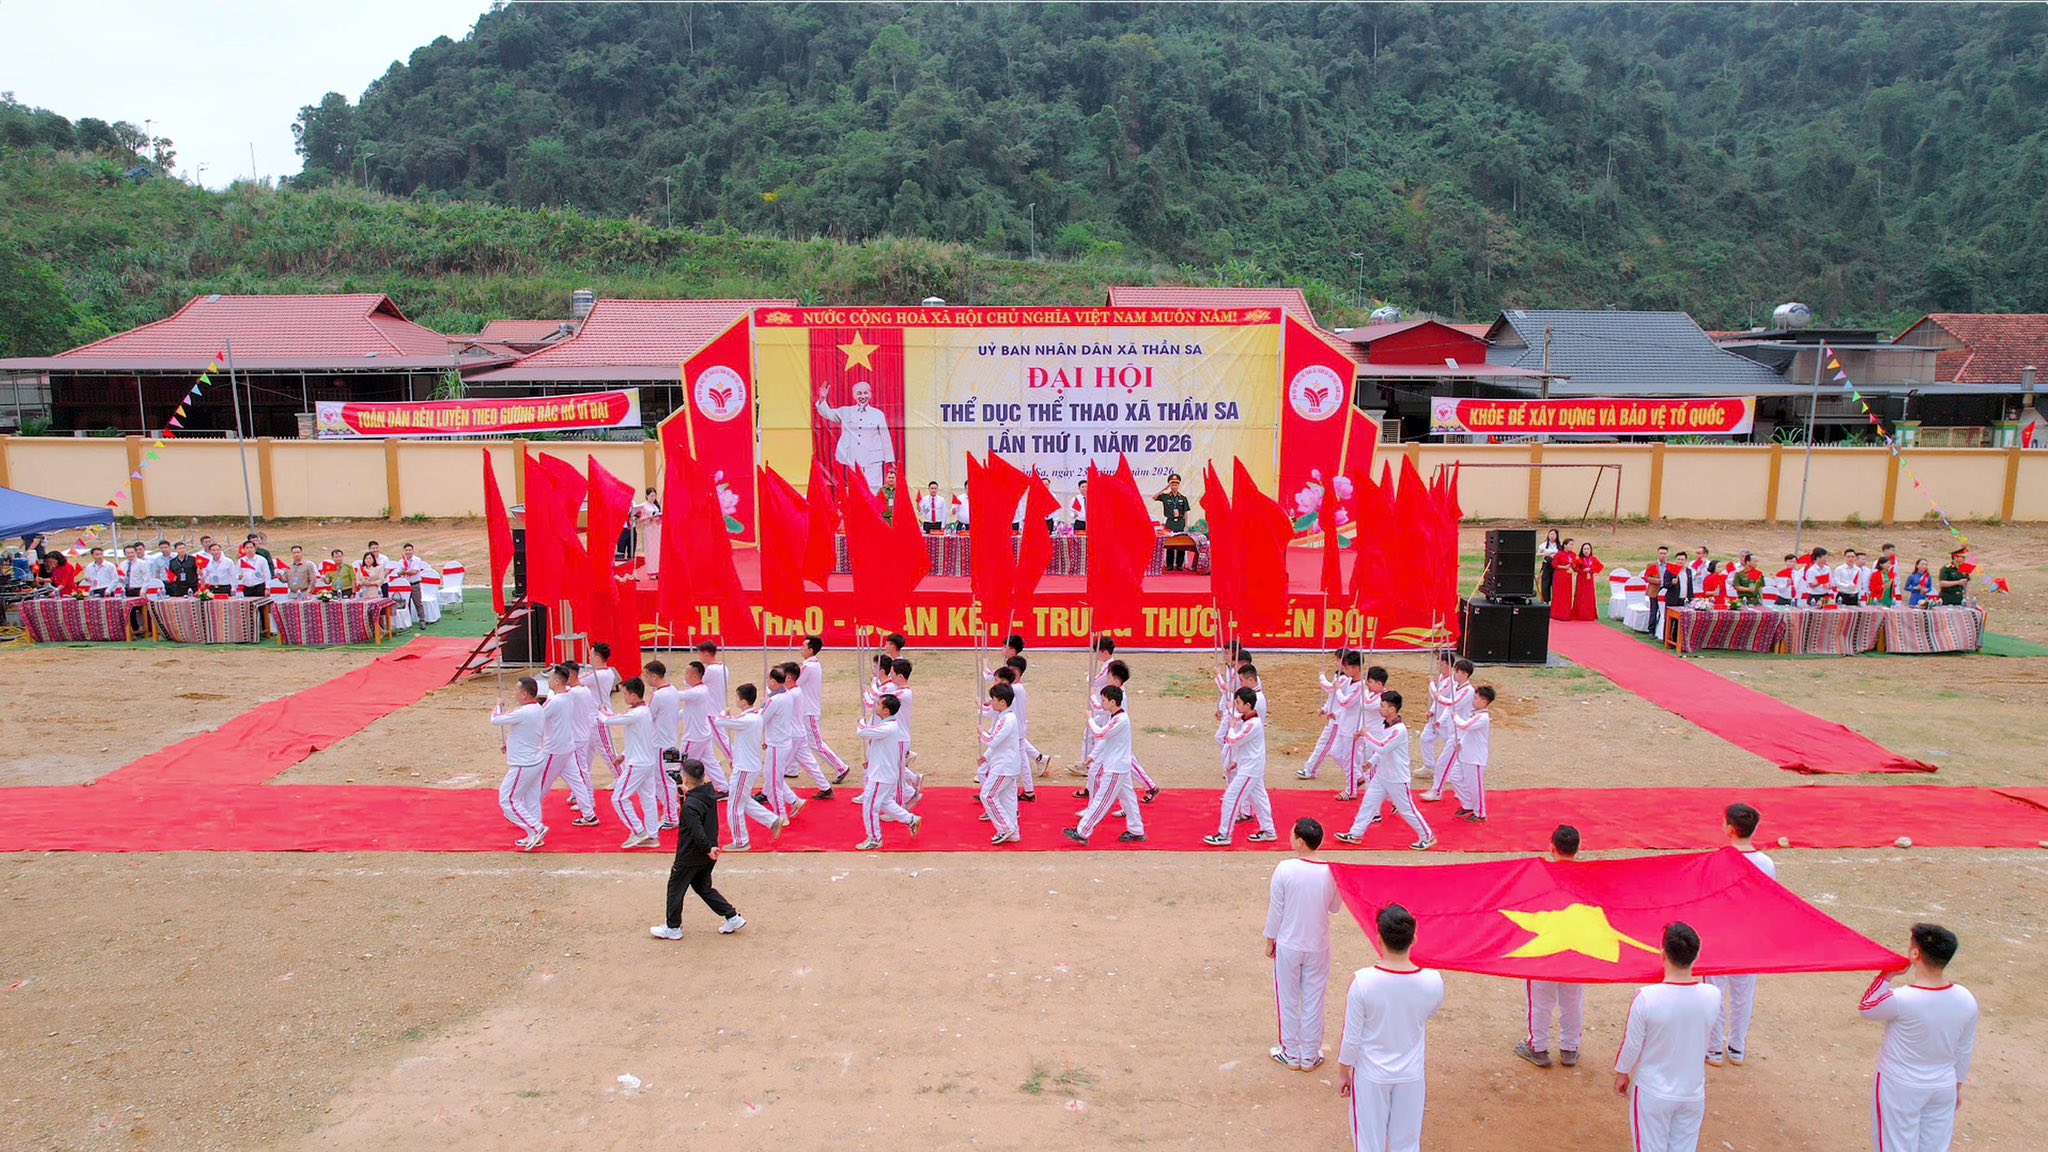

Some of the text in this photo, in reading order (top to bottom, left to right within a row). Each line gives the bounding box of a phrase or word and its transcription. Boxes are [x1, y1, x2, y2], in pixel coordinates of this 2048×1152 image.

[803, 308, 1238, 328] NƯỚC CỘNG HOÀ XÃ HỘI CHỦ NGHĨA VIỆT NAM MUÔN NĂM!
[978, 339, 1203, 356] UỶ BAN NHÂN DÂN XÃ THẦN SA
[1027, 363, 1153, 394] ĐẠI HỘI
[357, 408, 386, 429] TOÀN
[387, 408, 409, 428] DÂN
[412, 407, 433, 427] RÈN
[436, 406, 470, 432] LUYỆN
[472, 407, 497, 426] THEO
[500, 405, 535, 425] GƯƠNG
[537, 403, 559, 423] BÁC
[577, 401, 588, 420] VĨ
[590, 401, 610, 423] ĐẠI
[940, 396, 1239, 426] THỂ DỤC THỂ THAO XÃ THẦN SA
[1469, 402, 1726, 430] KHỎE ĐỂ XÂY DỰNG VÀ BẢO VỆ TỔ QUỐC
[987, 429, 1192, 455] LẦN THỨ I, NĂM 2026
[1051, 467, 1075, 479] ngày
[1152, 465, 1175, 477] 2026
[1032, 605, 1132, 638] TRU
[1141, 604, 1218, 644] THỰC
